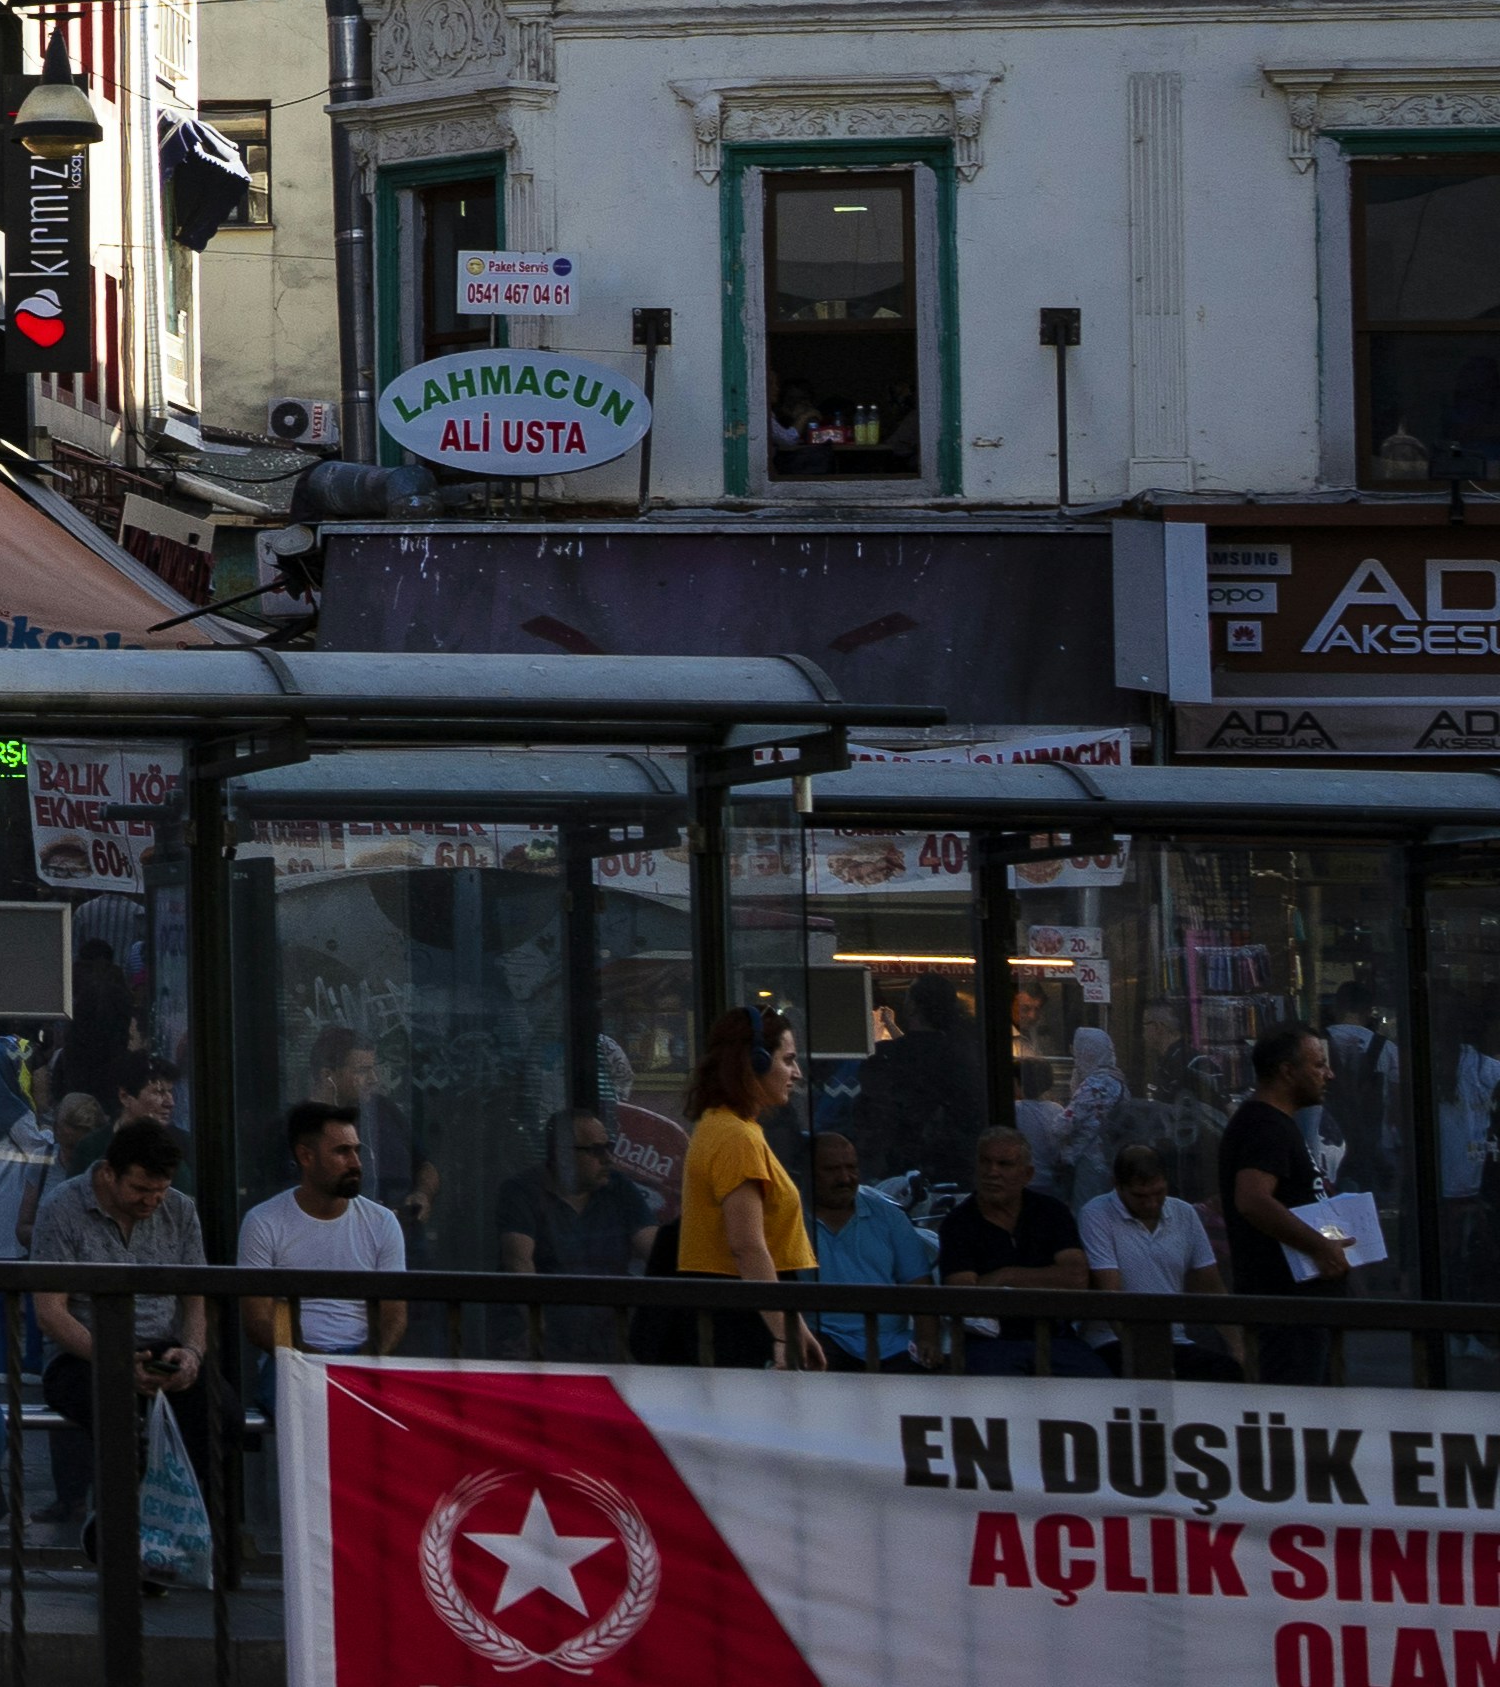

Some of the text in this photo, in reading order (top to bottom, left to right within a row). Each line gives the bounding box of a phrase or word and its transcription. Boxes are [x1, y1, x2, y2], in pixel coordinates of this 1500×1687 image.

[488, 261, 549, 273] Paket Servis
[467, 283, 570, 305] 0541 467 04 61
[392, 365, 636, 427] LAHMACUN
[439, 413, 587, 454] ALİ USTA
[1206, 552, 1278, 566] AMSUNG
[1208, 588, 1264, 605] ppo
[1206, 710, 1339, 749] ADA
[1211, 737, 1325, 749] AKSESUAR
[36, 760, 111, 796] BALIK
[900, 1414, 1013, 1491] EN
[1038, 1407, 1369, 1516] DÜŞÜK
[968, 1511, 1248, 1607] AÇLIK
